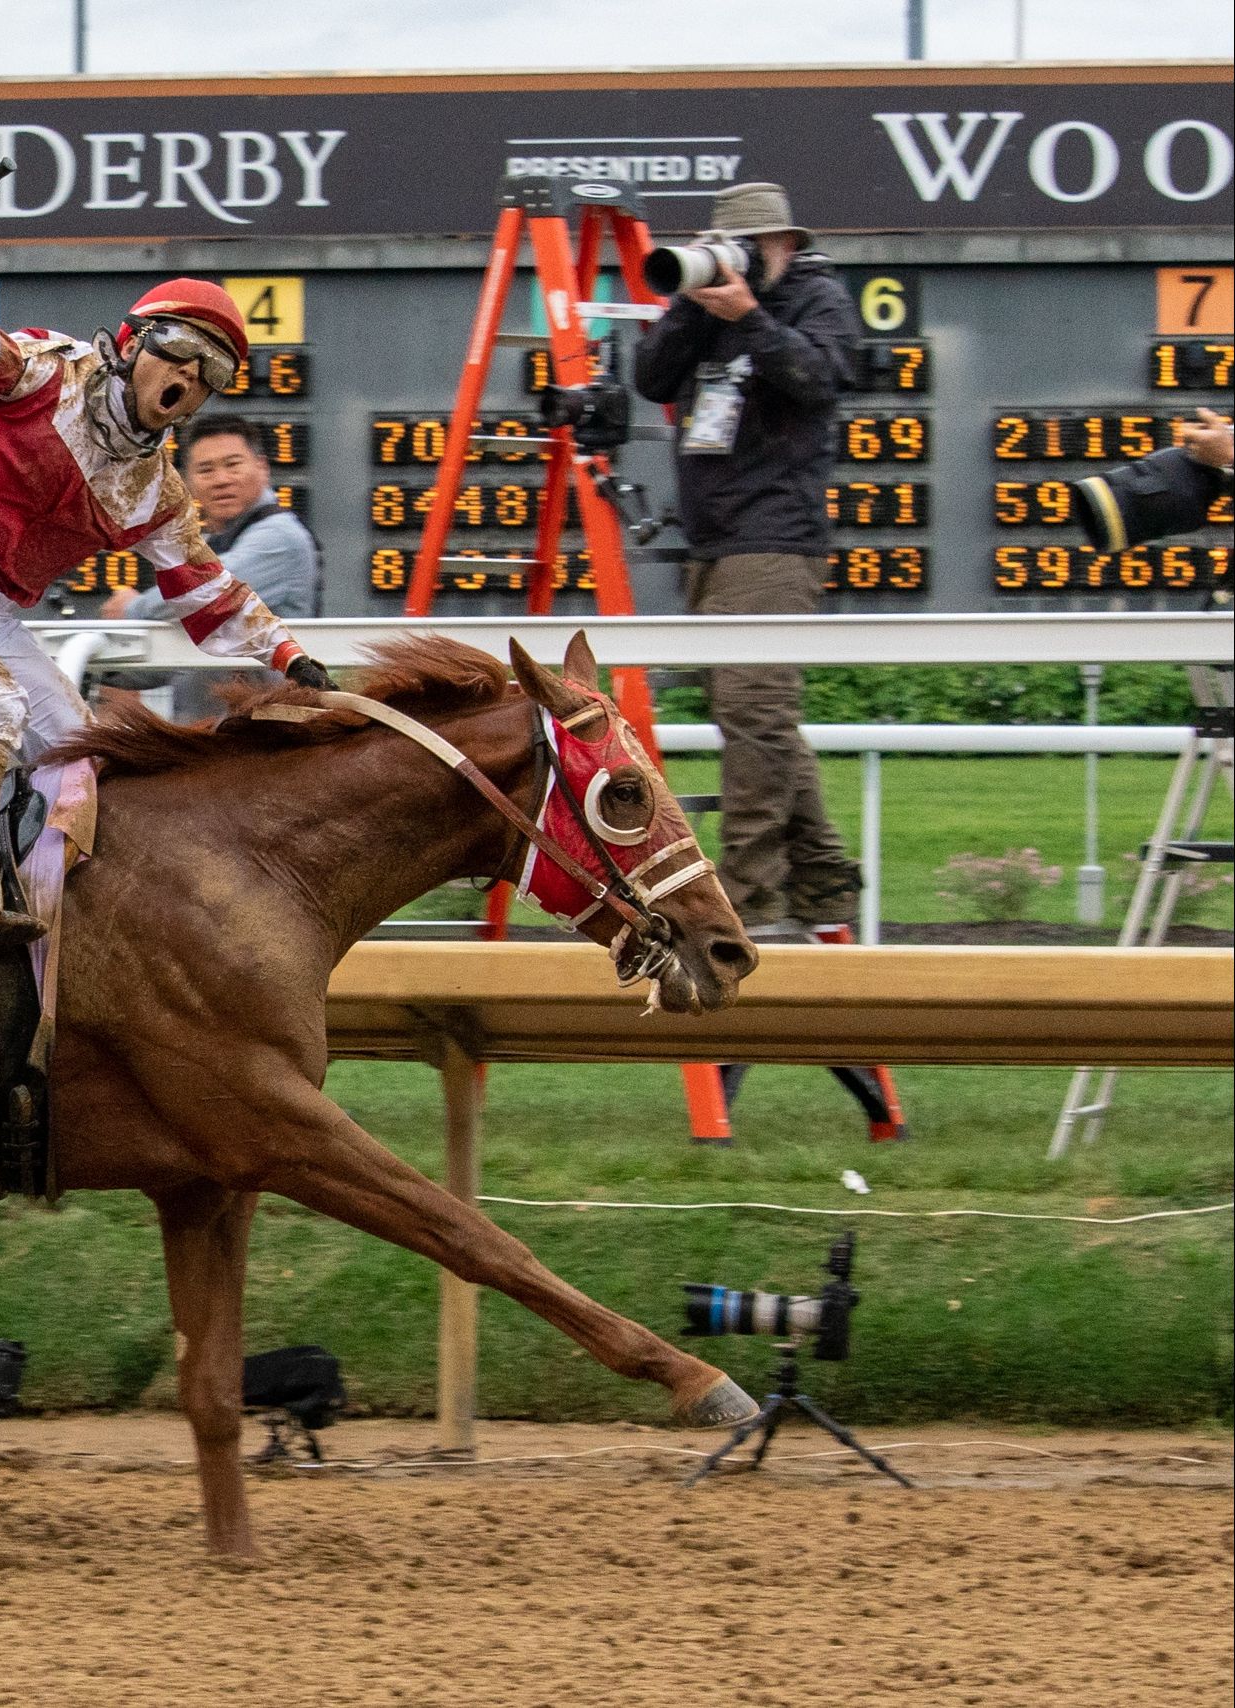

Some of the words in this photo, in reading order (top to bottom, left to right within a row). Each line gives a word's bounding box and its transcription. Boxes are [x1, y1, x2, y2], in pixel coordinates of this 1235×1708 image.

[506, 155, 690, 181] PRESENTED
[695, 155, 742, 181] BY
[872, 111, 1233, 202] WOO
[246, 285, 280, 336] 4
[860, 277, 906, 331] 6
[1181, 275, 1214, 327] 7
